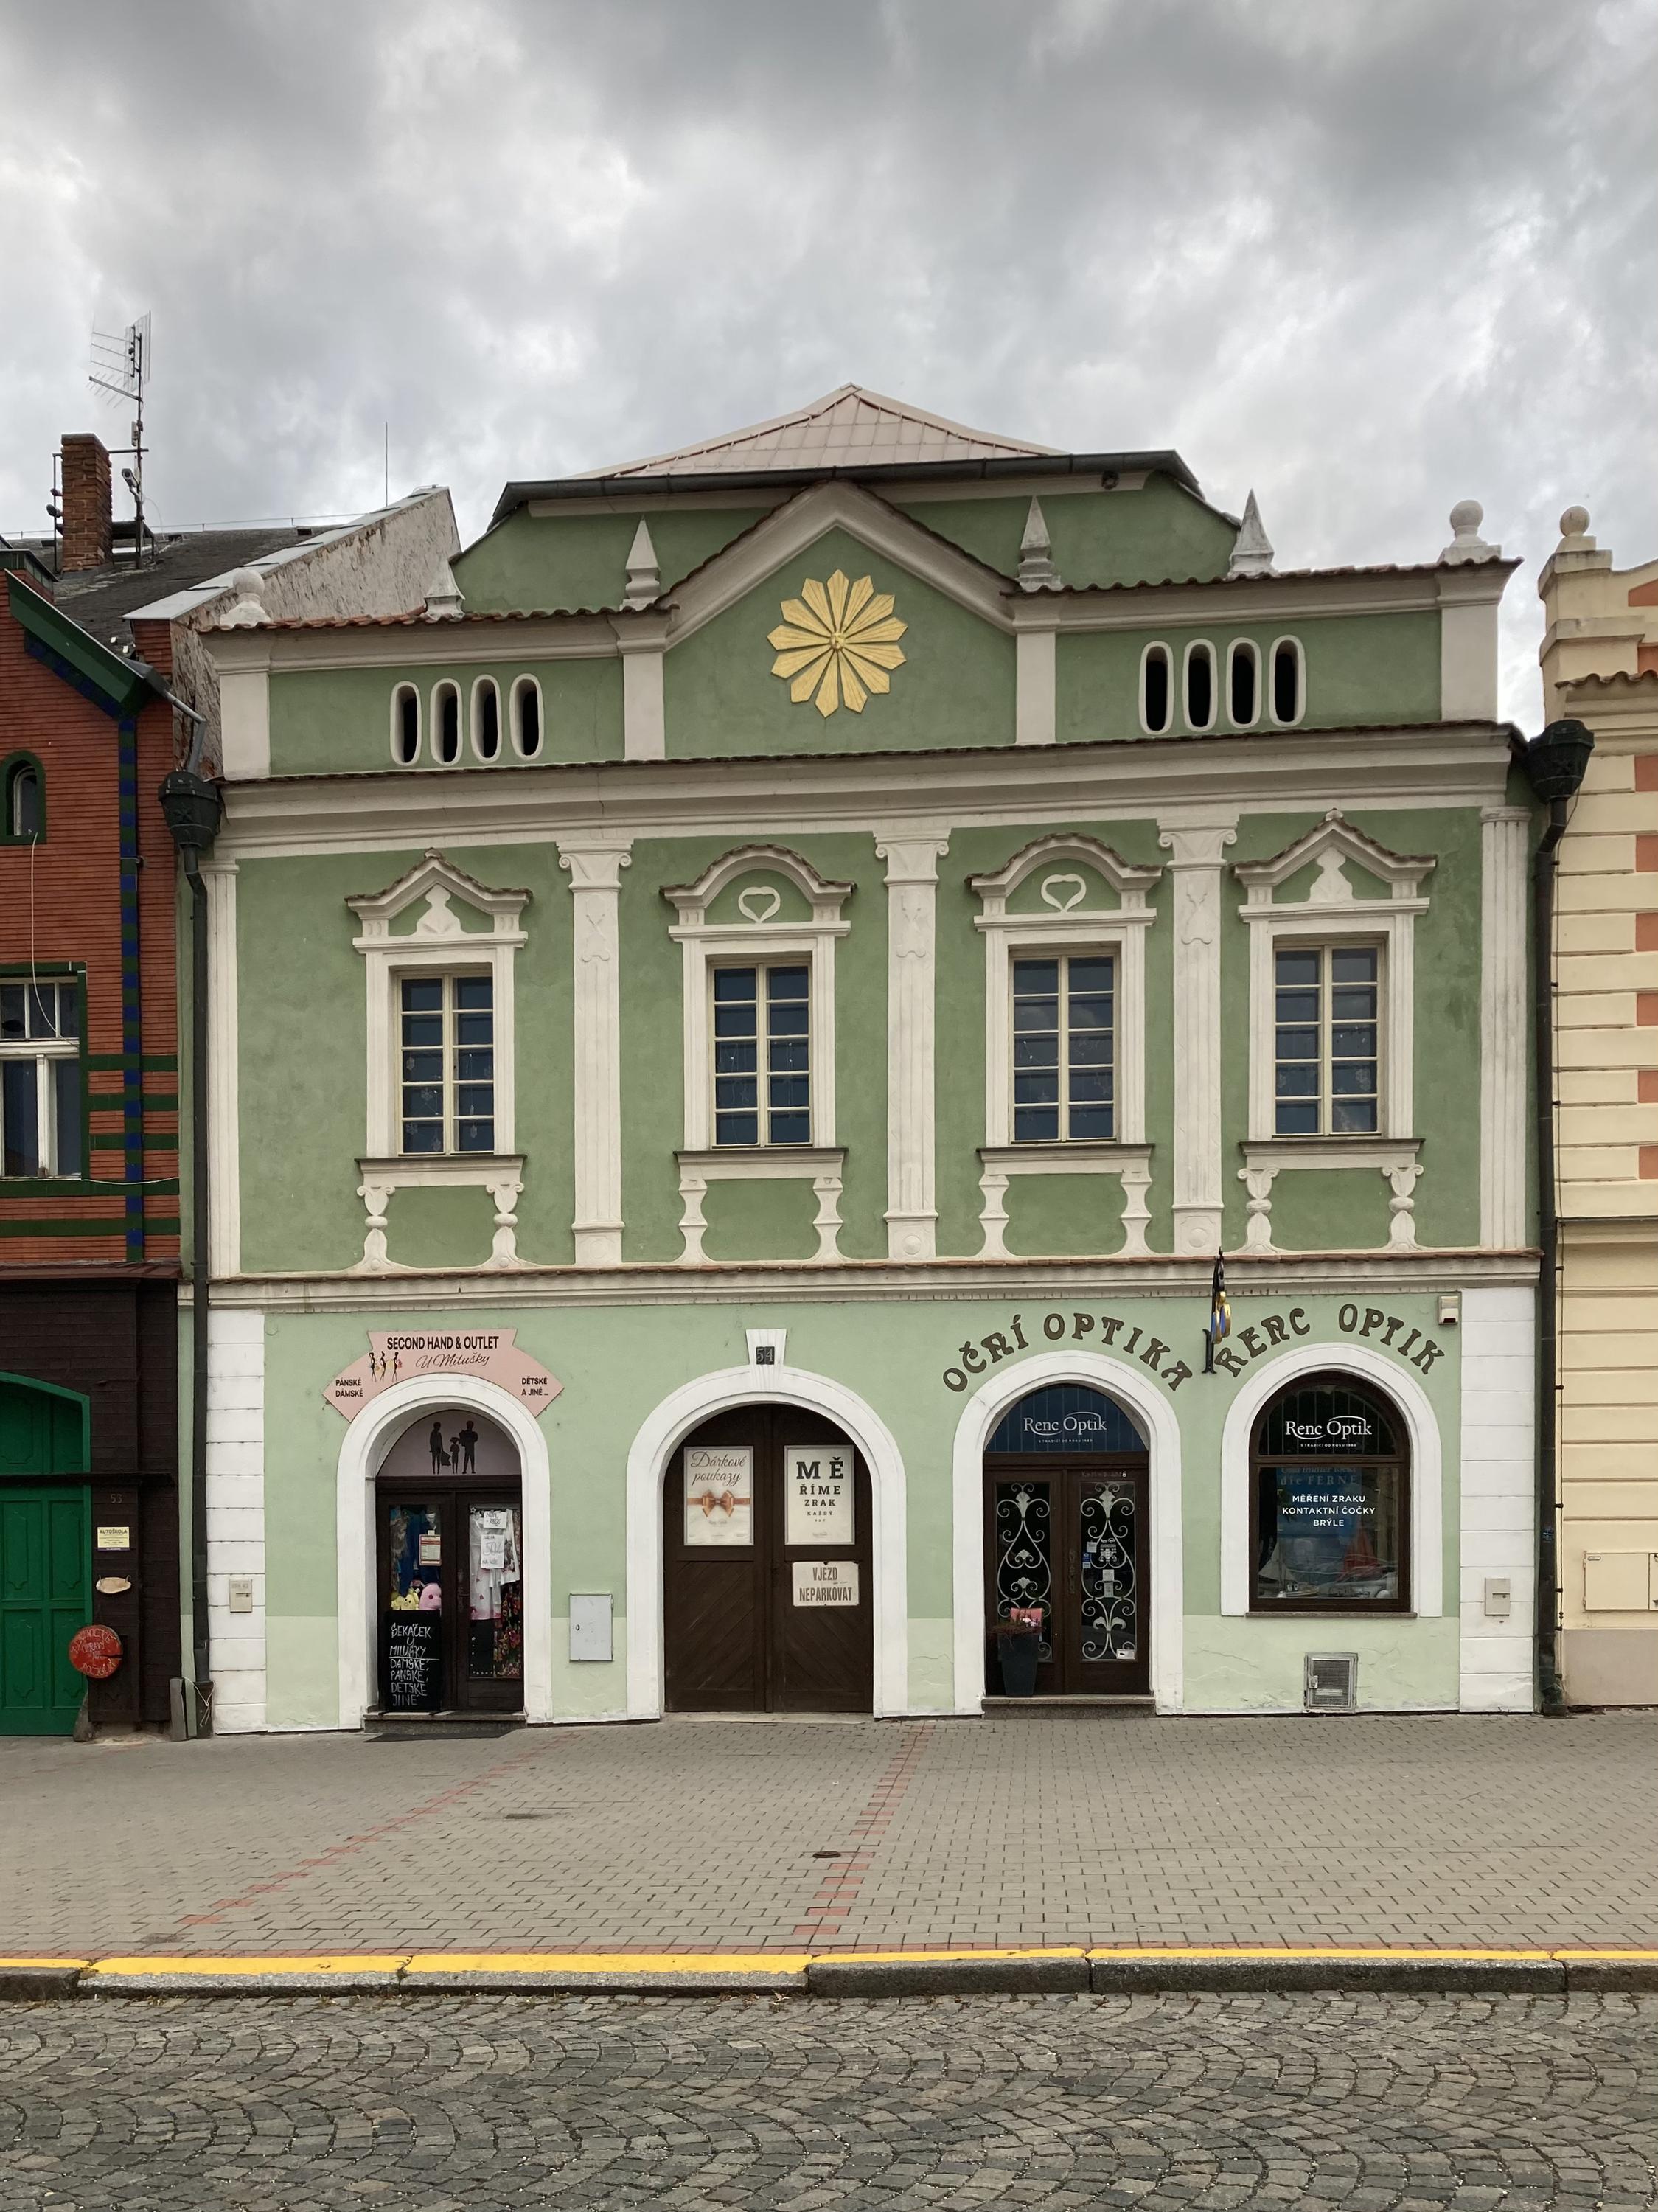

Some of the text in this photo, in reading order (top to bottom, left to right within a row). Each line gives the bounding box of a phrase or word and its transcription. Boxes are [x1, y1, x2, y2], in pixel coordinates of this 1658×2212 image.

[387, 1335, 499, 1350] SECOND HAND & OUTLET
[1338, 1303, 1445, 1375] OPTIK
[756, 1348, 773, 1363] 54
[1043, 1312, 1193, 1391] OPTIKA
[415, 1352, 490, 1368] U Milušky
[335, 1377, 362, 1386] PÁNSKÉ
[521, 1375, 548, 1385] DĚTSKÉ
[335, 1388, 363, 1397] DÁMSKÉ
[528, 1386, 543, 1396] JINÉ
[1023, 1411, 1107, 1436] Renc Optik
[1285, 1415, 1372, 1440] Renc Optik
[690, 1451, 747, 1468] Dárkové
[691, 1468, 742, 1486] poukazy
[1281, 1475, 1356, 1485] die FERNE
[799, 1484, 840, 1495] ŘÍME
[111, 1494, 122, 1503] 53
[1292, 1494, 1329, 1503] MĚŘENÍ
[1282, 1506, 1376, 1514] KONTAKTNÍ ČOČKY
[1313, 1517, 1345, 1527] BRÝLE
[812, 1567, 838, 1581] VJEZD
[799, 1587, 852, 1601] NEPARKOVAT
